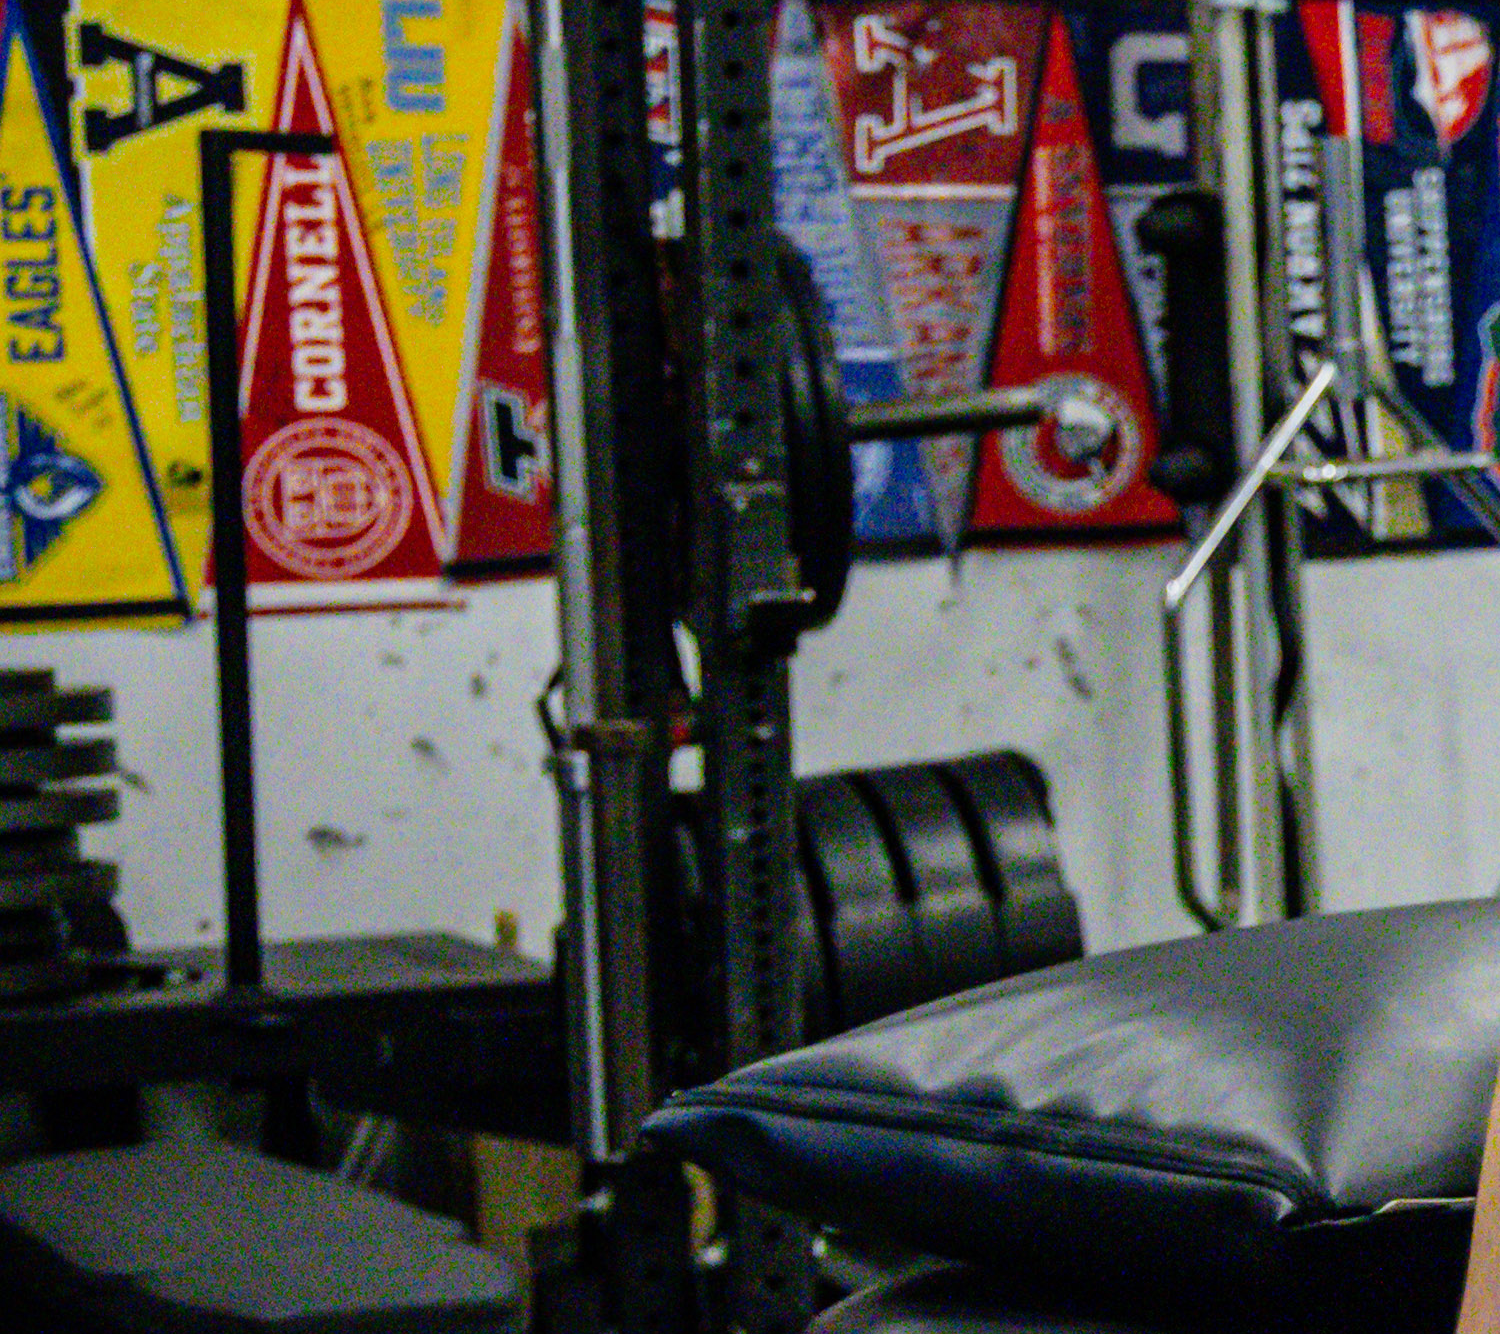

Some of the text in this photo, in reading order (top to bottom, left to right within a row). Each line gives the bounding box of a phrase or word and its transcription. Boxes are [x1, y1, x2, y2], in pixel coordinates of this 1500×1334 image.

[79, 21, 246, 154] A
[2, 184, 65, 364] EAGLES
[130, 260, 163, 355] State
[282, 157, 349, 414] CORNELL
